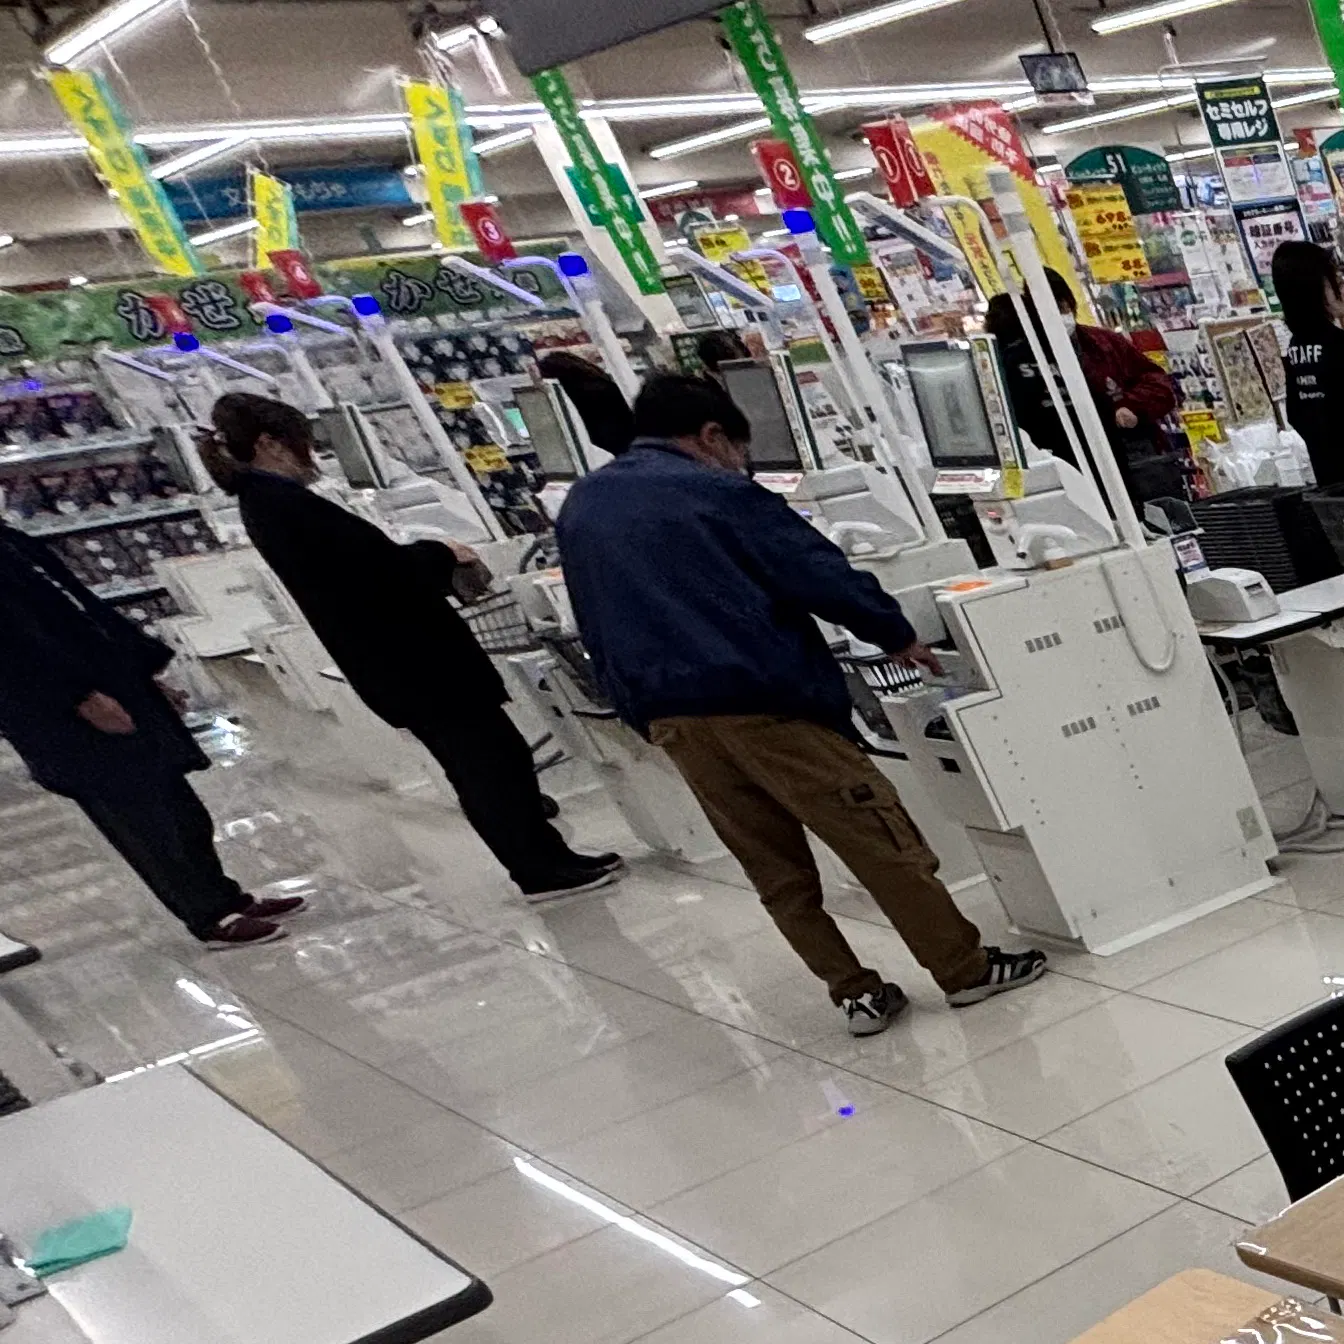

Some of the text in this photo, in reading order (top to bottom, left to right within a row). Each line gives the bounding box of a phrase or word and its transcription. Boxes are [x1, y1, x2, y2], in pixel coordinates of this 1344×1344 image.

[1206, 99, 1268, 121] セミセルフ
[1287, 344, 1323, 365] STAFF
